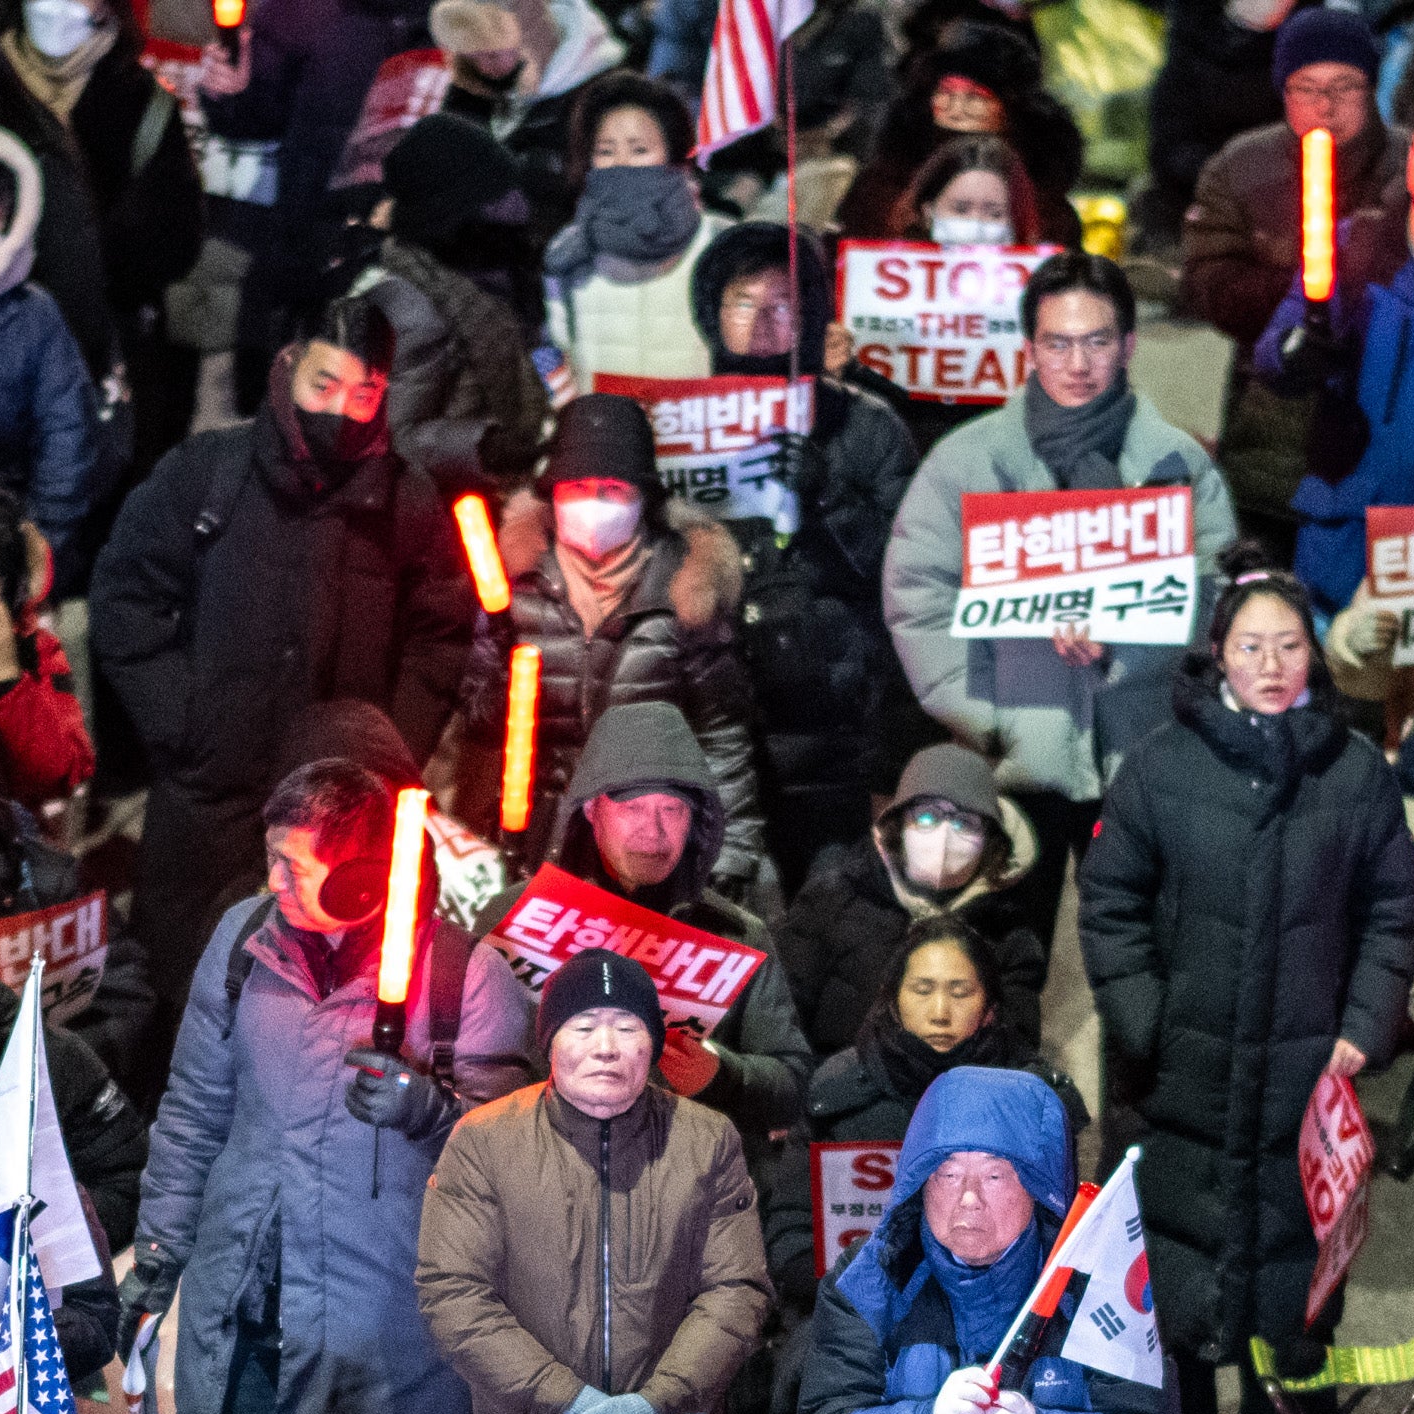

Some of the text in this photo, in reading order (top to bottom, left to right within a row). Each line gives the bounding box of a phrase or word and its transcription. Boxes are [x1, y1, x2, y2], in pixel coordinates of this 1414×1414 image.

[915, 312, 986, 338] THE
[969, 494, 1188, 585] 탄핵반대
[960, 573, 1189, 629] 이재명 구속
